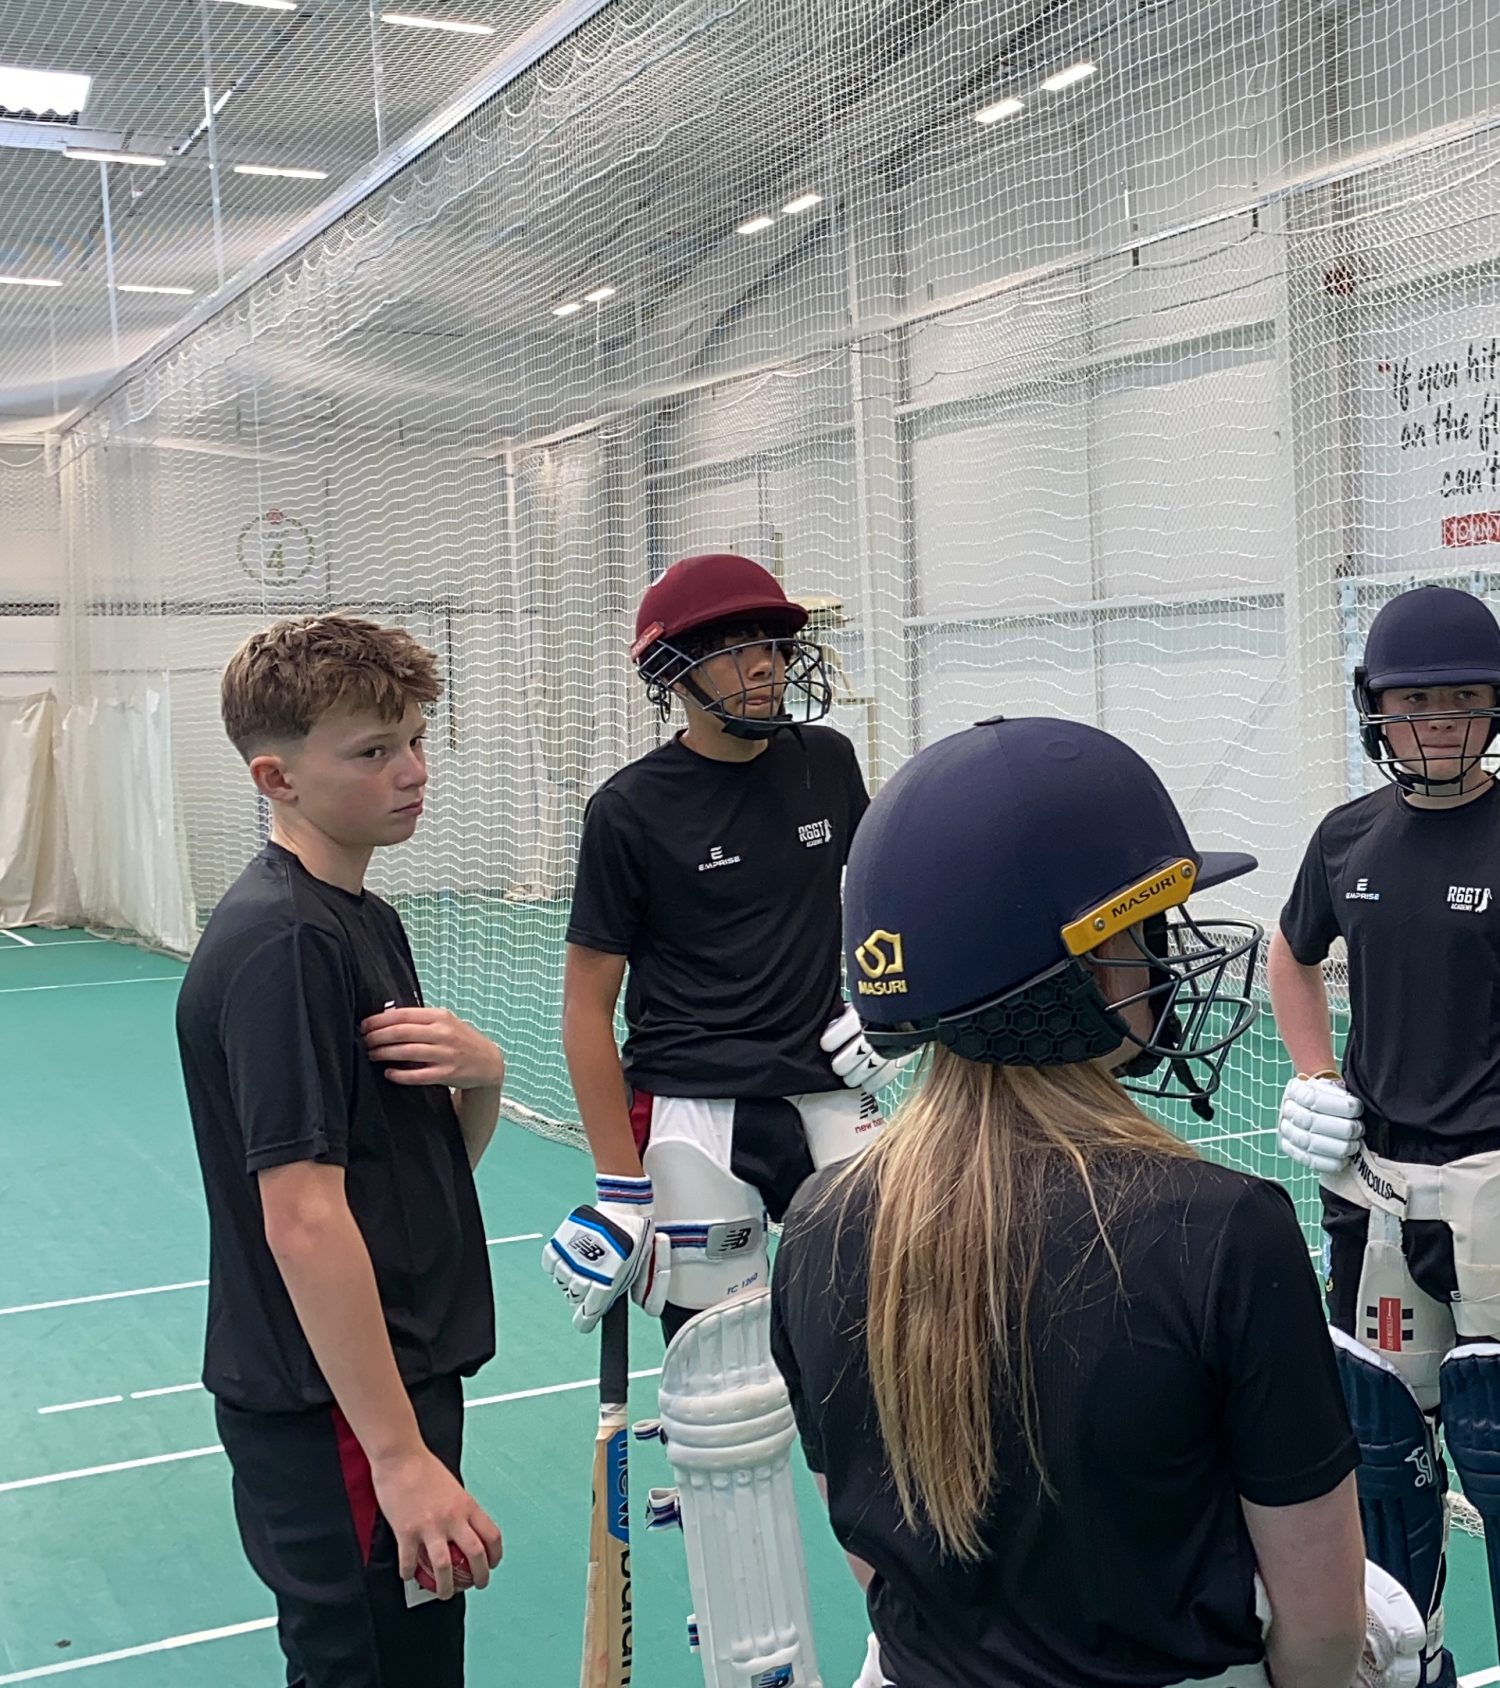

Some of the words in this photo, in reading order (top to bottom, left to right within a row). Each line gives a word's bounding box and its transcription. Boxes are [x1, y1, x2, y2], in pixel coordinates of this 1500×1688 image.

[1418, 361, 1458, 403] you
[1434, 402, 1472, 446] the
[698, 855, 741, 871] EMPRISE
[1111, 874, 1177, 918] MASURI
[1345, 892, 1380, 901] EMPRISE
[1450, 903, 1473, 912] ACADEMY
[857, 979, 908, 996] MASURI
